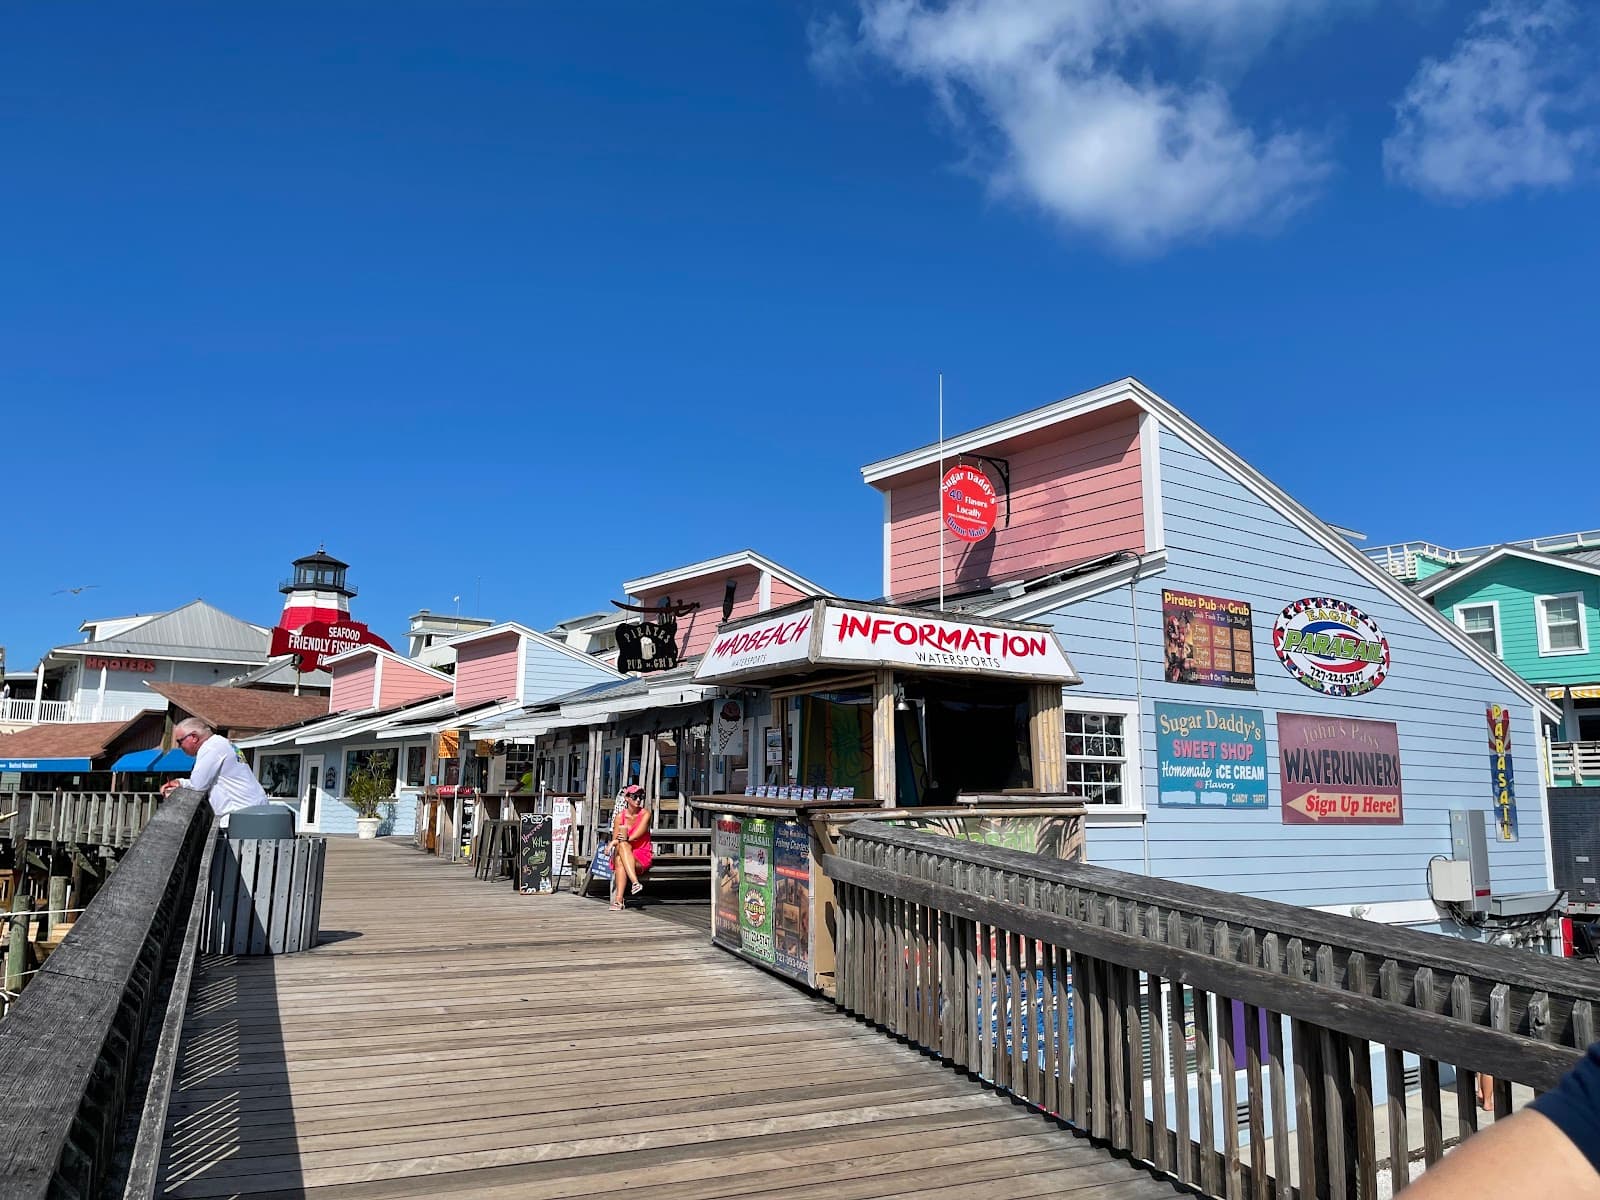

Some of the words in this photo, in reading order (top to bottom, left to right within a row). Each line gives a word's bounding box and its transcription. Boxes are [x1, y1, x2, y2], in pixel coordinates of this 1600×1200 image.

[941, 471, 964, 492] Sugar
[967, 471, 996, 504] Daddy's
[965, 496, 988, 508] Flavors
[956, 504, 982, 519] Locally
[1164, 592, 1196, 607] Pirates
[1305, 609, 1359, 629] EAGLE
[328, 627, 360, 641] SEAFOOD
[624, 625, 670, 644] PIRATES
[832, 613, 1046, 658] INFORMATION
[288, 635, 331, 653] FRIENDLY
[1283, 630, 1383, 663] PARASAIL
[85, 657, 156, 672] HOOTERS
[627, 659, 642, 669] PUB
[732, 654, 766, 667] WATERSPORTS
[915, 652, 1001, 668] WATERSPORTS
[1160, 714, 1201, 736] Sugar
[1205, 709, 1261, 741] Daddy's
[1303, 723, 1346, 745] John's
[1351, 723, 1379, 749] Pass
[1173, 739, 1217, 760] SWEET
[1220, 742, 1253, 761] SHOP
[1161, 761, 1212, 778] Homemade
[1233, 765, 1265, 781] CREAM
[1283, 747, 1399, 787] WAVERUNNERS
[1491, 704, 1510, 840] PARASAIL
[1204, 780, 1236, 790] Flavors
[1305, 794, 1337, 816] Sign
[1340, 795, 1360, 816] Up
[1362, 796, 1397, 813] Here!
[748, 822, 767, 834] EAGLE
[742, 833, 770, 847] PARASAIL
